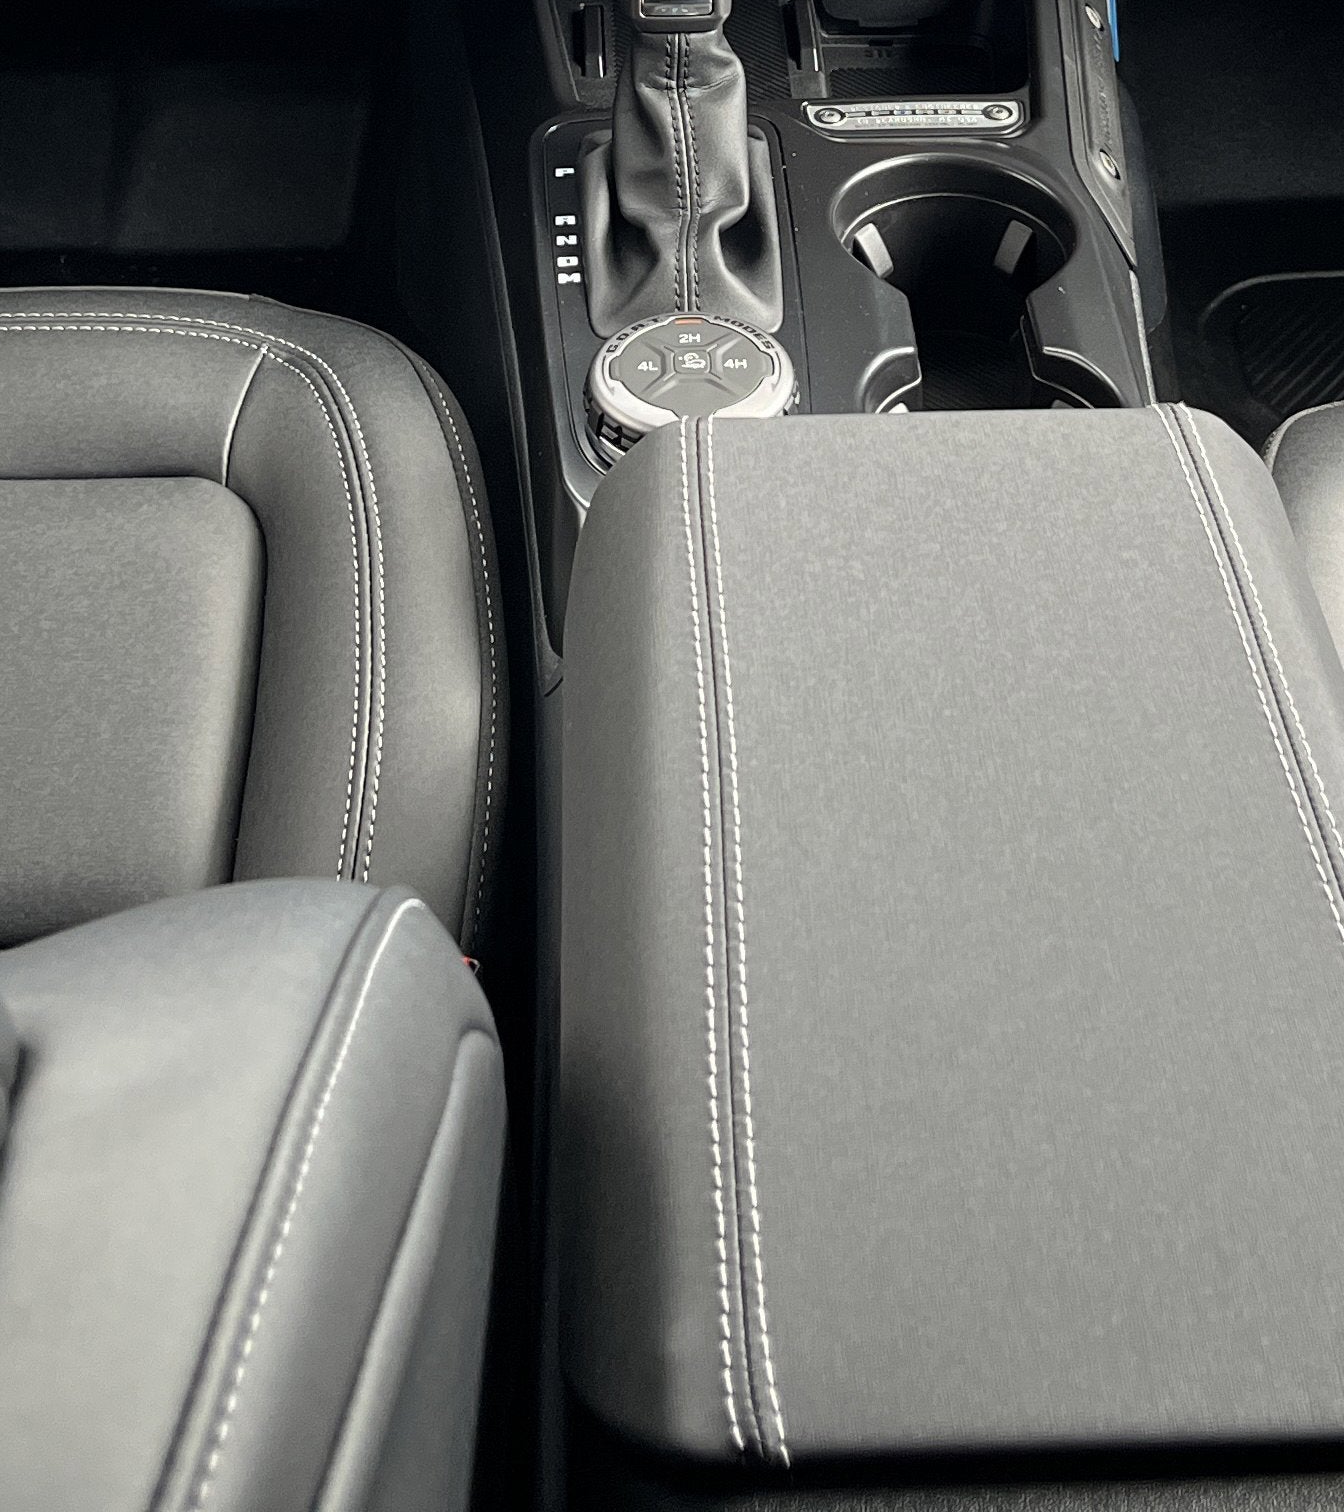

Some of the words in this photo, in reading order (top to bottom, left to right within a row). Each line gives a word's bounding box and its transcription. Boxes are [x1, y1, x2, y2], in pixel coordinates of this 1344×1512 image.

[555, 167, 575, 178] P
[555, 215, 576, 226] R
[556, 235, 577, 245] N
[557, 256, 578, 267] D
[558, 273, 581, 284] M
[713, 315, 775, 350] MODES
[678, 334, 701, 344] 2H
[637, 361, 659, 372] 4L
[724, 358, 748, 369] 4H
